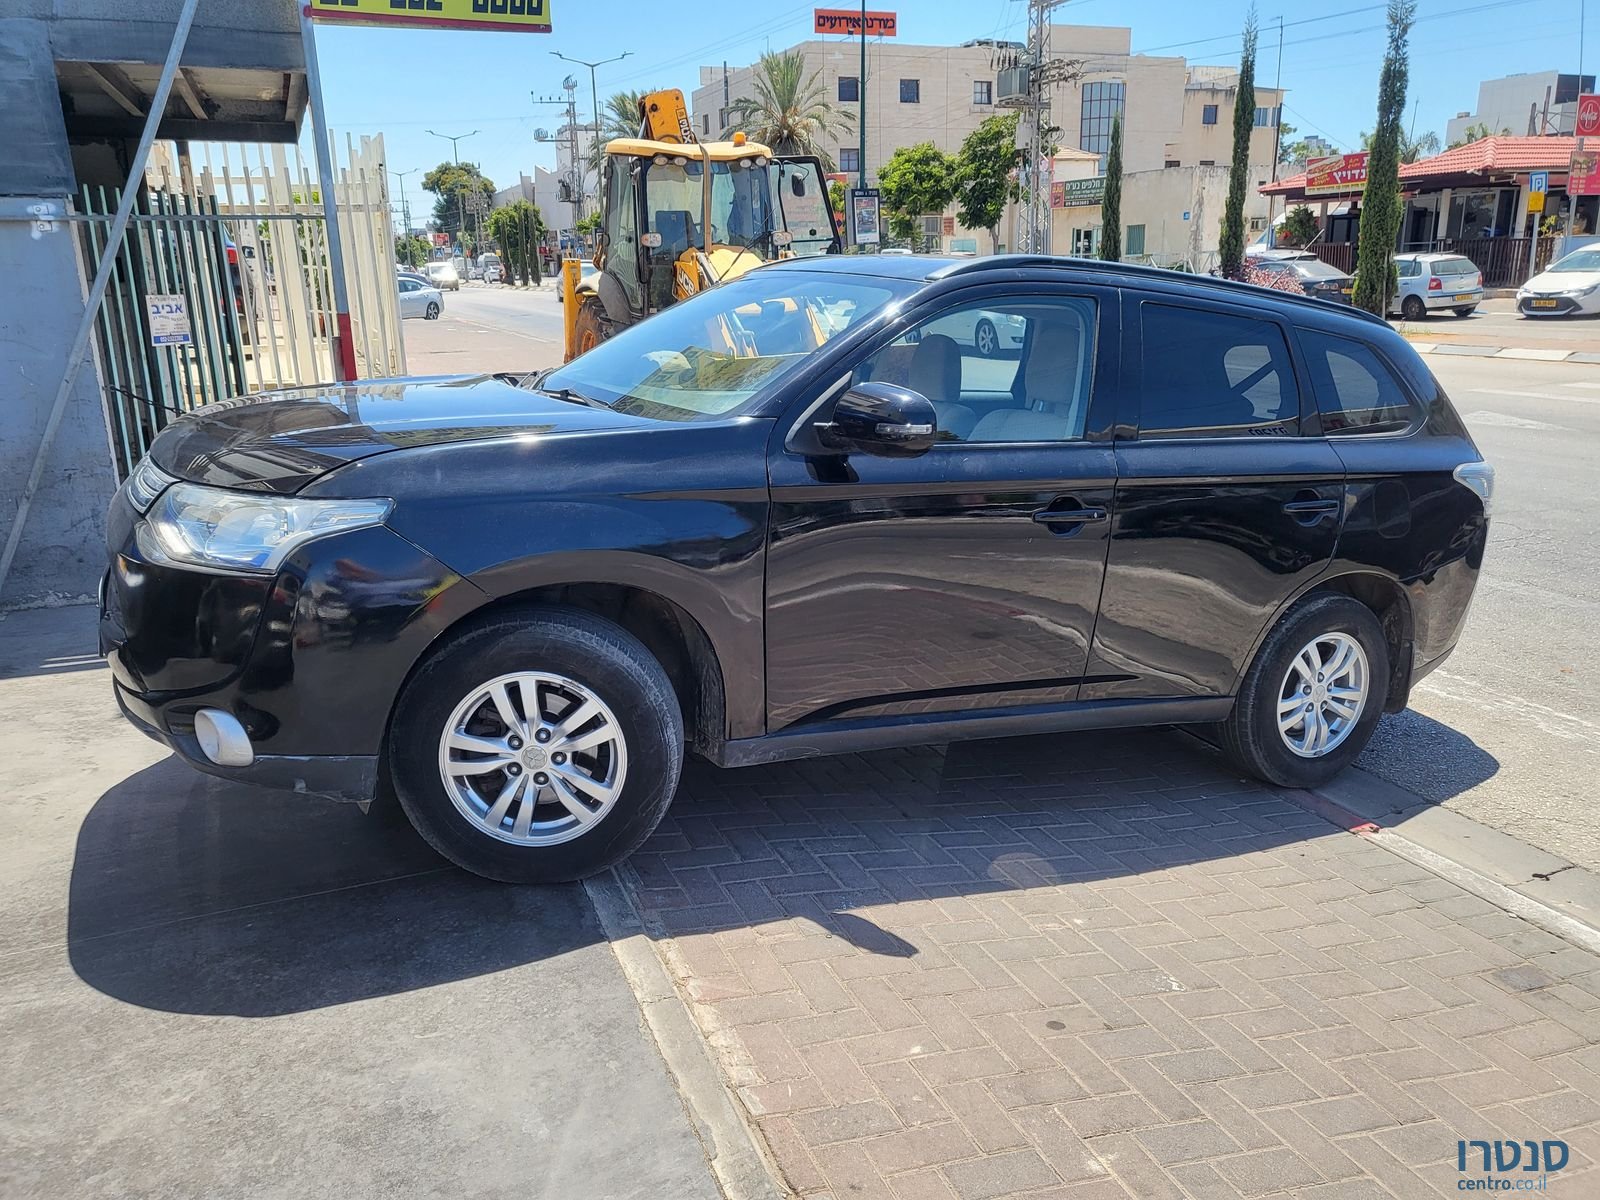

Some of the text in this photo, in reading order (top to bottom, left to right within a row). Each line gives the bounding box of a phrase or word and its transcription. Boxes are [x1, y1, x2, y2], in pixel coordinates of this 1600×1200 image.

[817, 15, 861, 29] אירועים
[679, 119, 693, 144] 3CX
[1333, 168, 1366, 184] נדויץ
[678, 268, 696, 296] JCB
[151, 304, 183, 314] אביב
